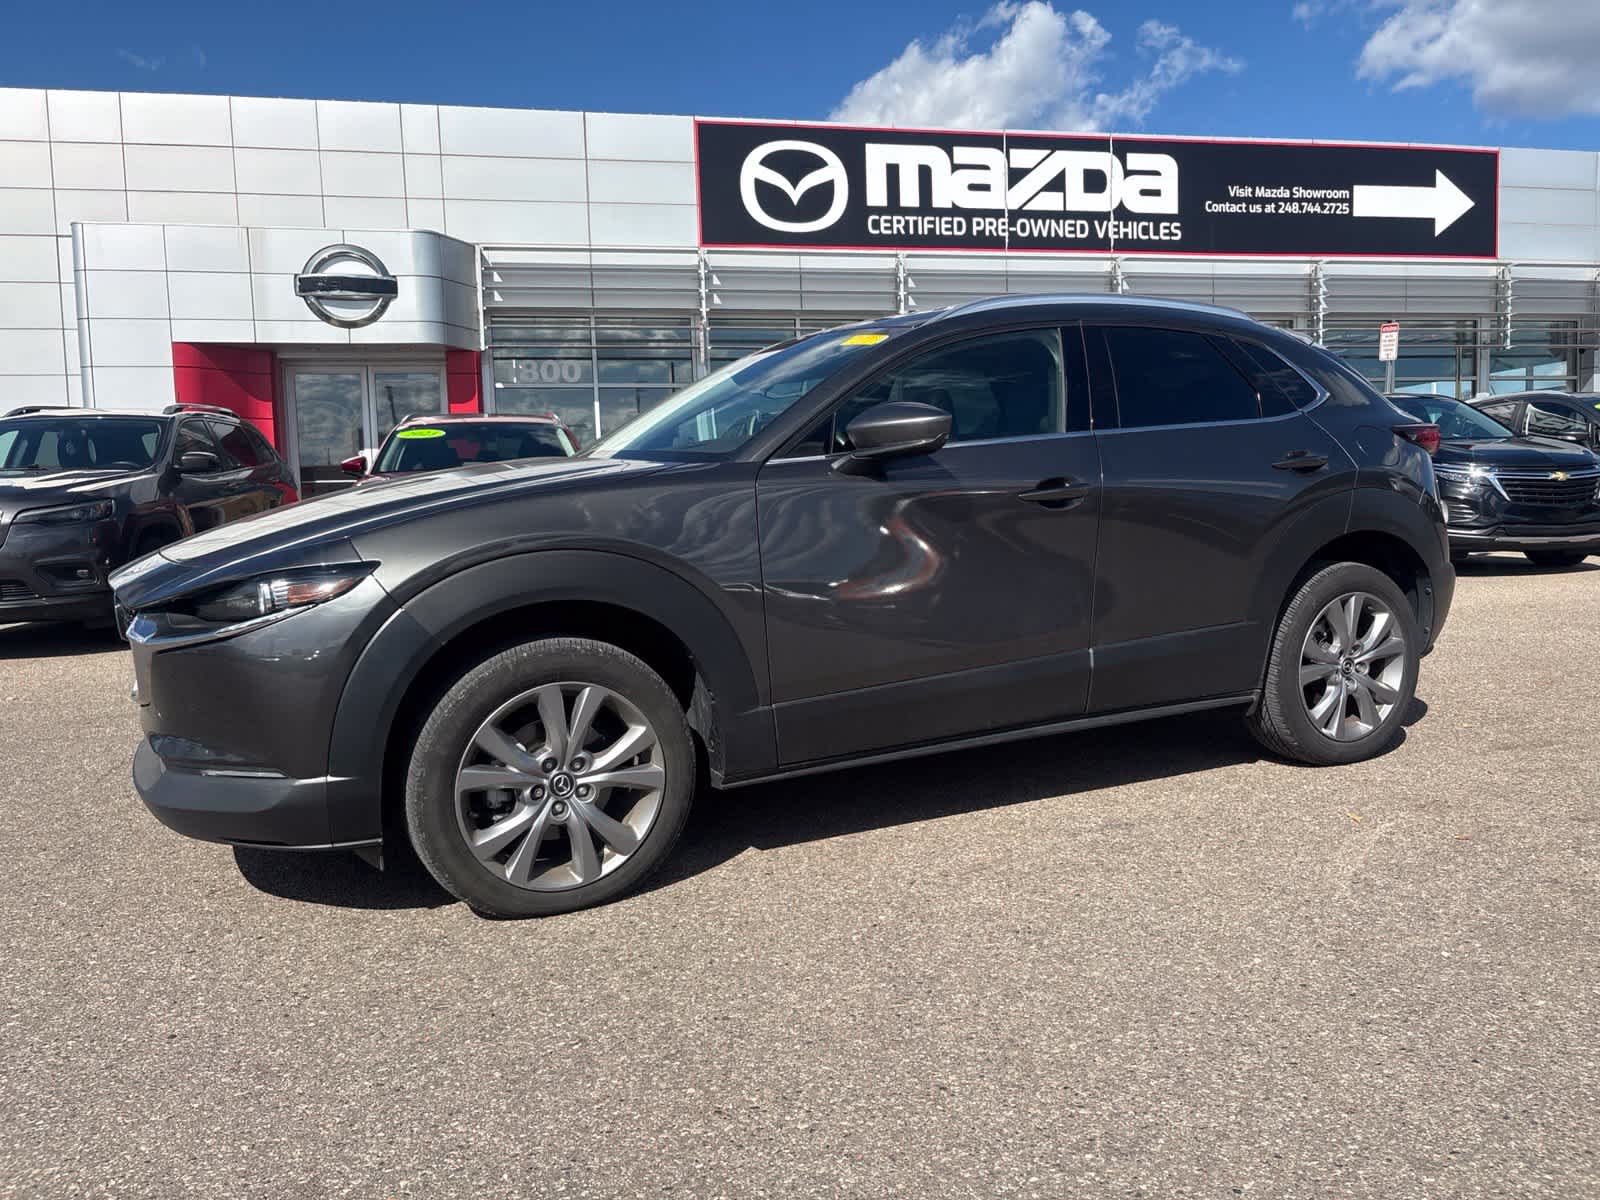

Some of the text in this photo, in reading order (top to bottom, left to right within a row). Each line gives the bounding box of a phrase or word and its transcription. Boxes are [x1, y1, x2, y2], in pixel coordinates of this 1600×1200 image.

[1228, 185, 1350, 199] Visit Mazda Showroom
[1205, 200, 1350, 215] Contact us at 248.744.2725
[867, 215, 1182, 240] CERTIFIED PRE-OWNED VEHICLES
